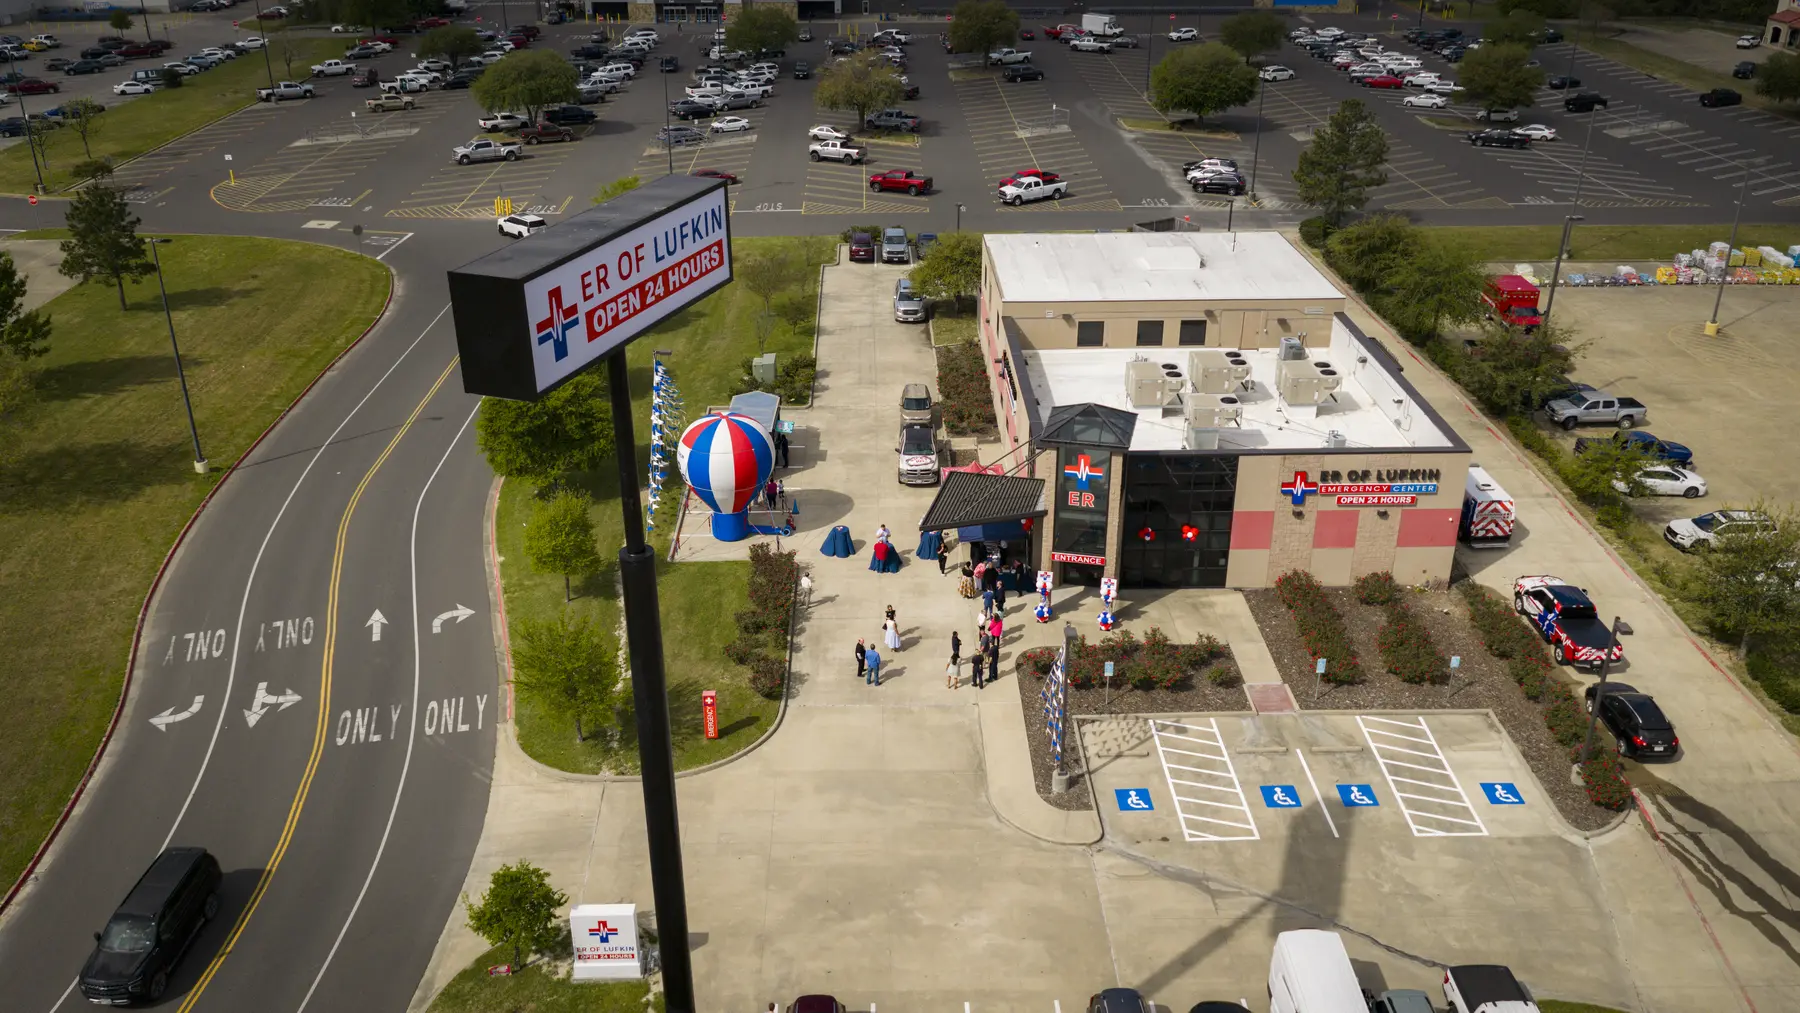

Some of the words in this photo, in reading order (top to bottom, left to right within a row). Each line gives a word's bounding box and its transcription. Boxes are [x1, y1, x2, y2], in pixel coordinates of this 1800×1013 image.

[526, 204, 557, 213] STOP
[755, 202, 783, 211] STOP
[1141, 198, 1169, 207] STOP
[580, 263, 610, 302] ER
[618, 243, 645, 281] OF
[653, 205, 722, 263] LUFKIN
[593, 290, 641, 332] OPEN
[645, 278, 664, 303] 24
[668, 245, 720, 291] HOURS
[1320, 470, 1342, 483] ER
[1347, 469, 1371, 483] OF
[1376, 468, 1441, 483] LUFKIN
[1321, 485, 1388, 493] EMERGENCY
[1392, 484, 1435, 492] CENTER
[1068, 491, 1095, 507] ER
[1340, 496, 1365, 504] OPEN
[1367, 496, 1379, 504] 24
[1380, 496, 1412, 504] HOURS
[1054, 554, 1102, 564] ENTRANCE
[255, 616, 314, 653] ONLY
[162, 628, 226, 666] ONLY
[425, 694, 488, 736] ONLY
[335, 704, 402, 746] ONLY
